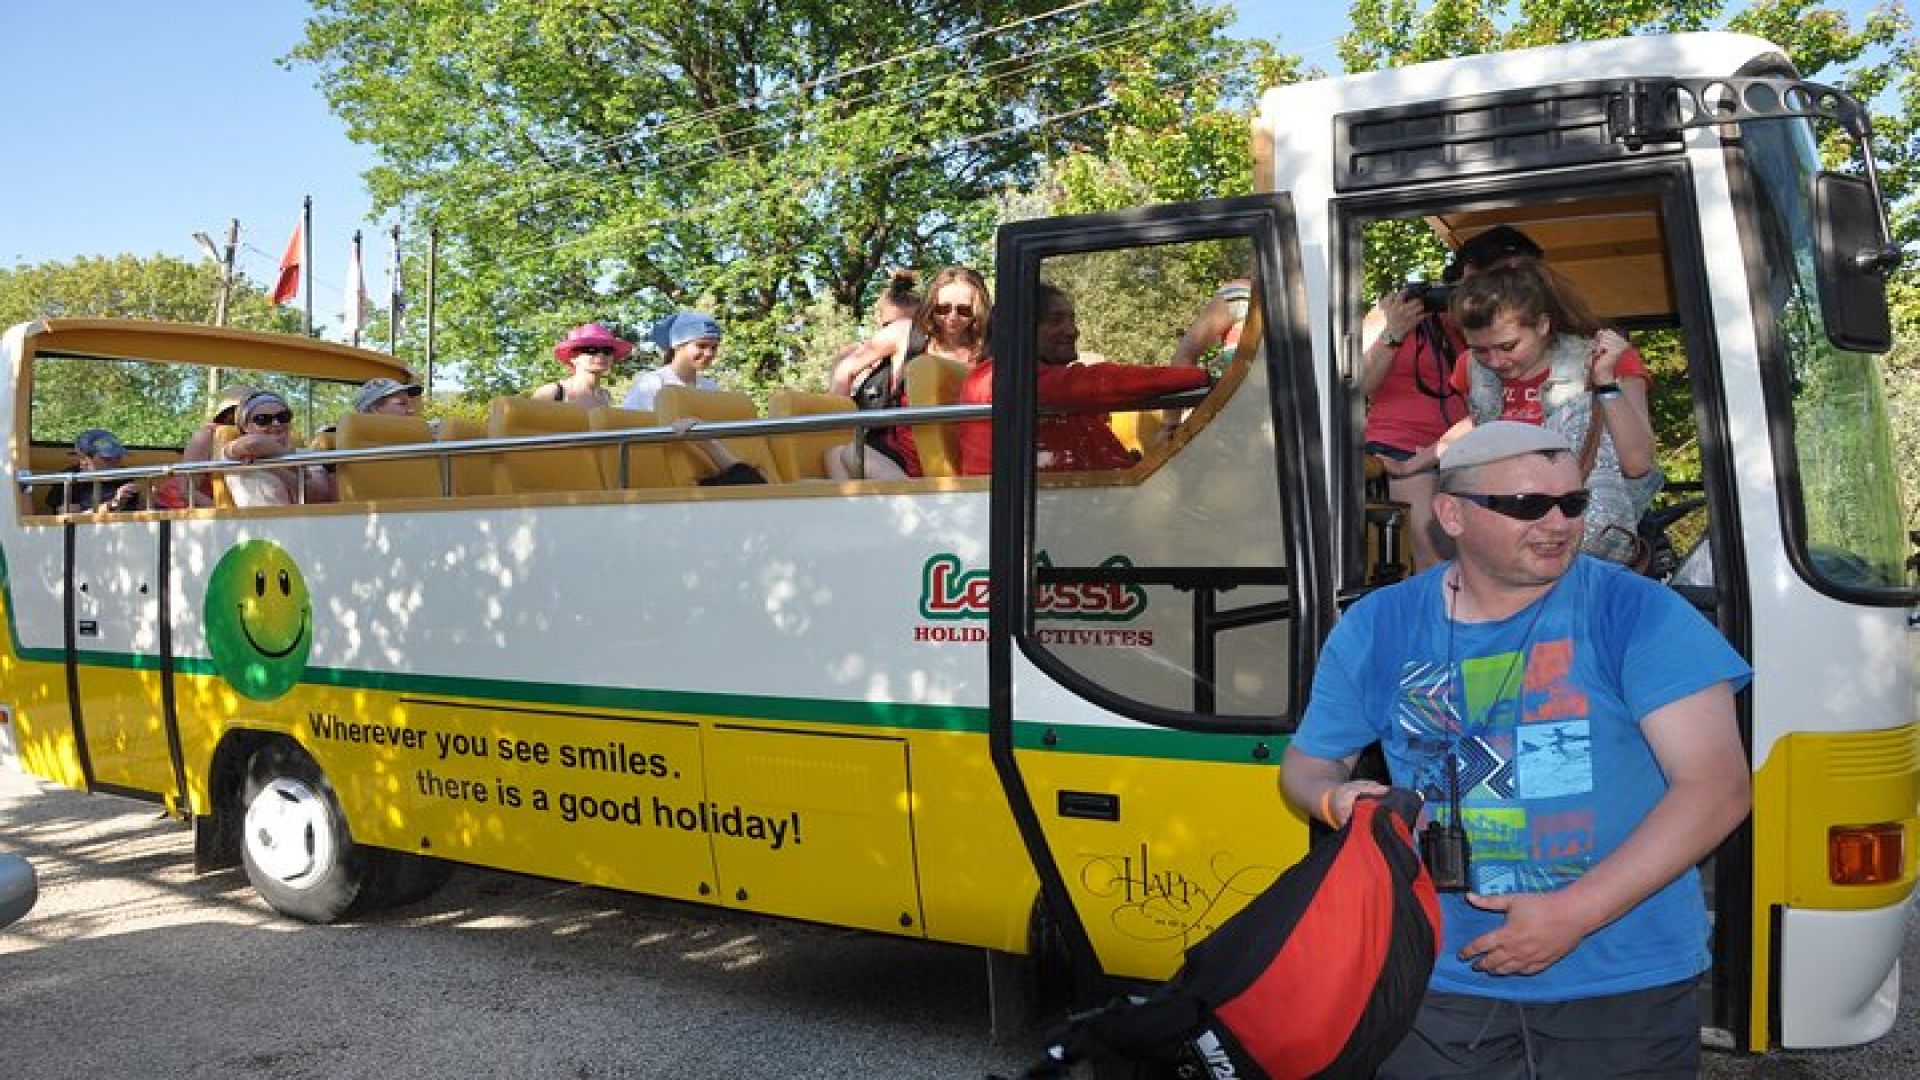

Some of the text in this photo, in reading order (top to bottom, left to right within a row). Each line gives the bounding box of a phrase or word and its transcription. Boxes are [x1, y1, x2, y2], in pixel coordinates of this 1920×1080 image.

[914, 627, 1152, 647] HOLID CTIVITES
[309, 712, 427, 750] Wherever
[435, 731, 488, 760] you
[498, 737, 549, 764] see
[416, 769, 801, 849] there is a good holiday!
